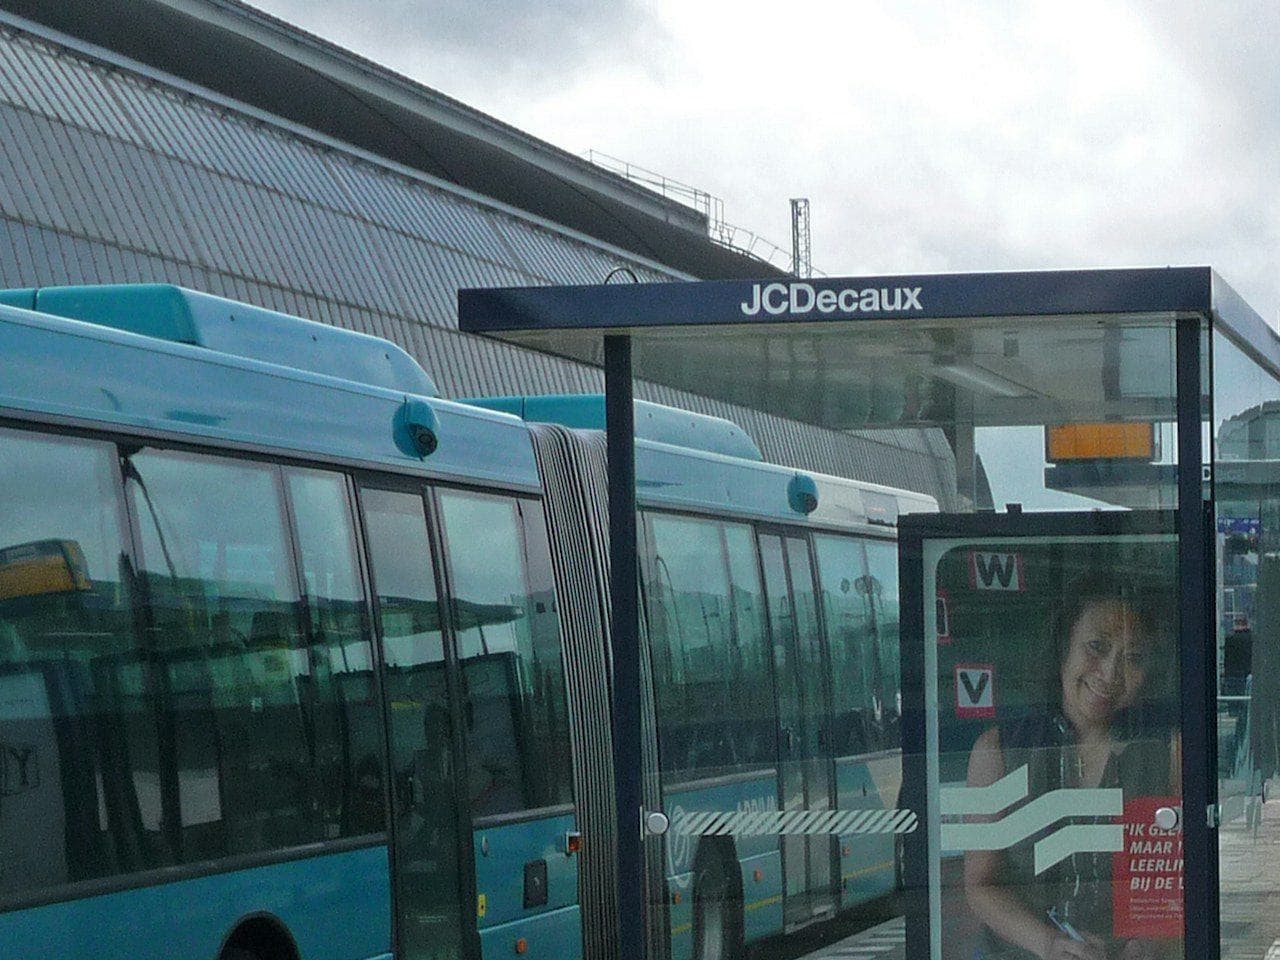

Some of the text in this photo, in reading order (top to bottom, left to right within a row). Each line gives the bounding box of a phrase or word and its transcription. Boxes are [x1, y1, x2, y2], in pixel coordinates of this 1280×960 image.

[741, 283, 923, 315] JCDecaux
[976, 554, 1014, 587] W
[960, 671, 990, 704] V
[1130, 841, 1172, 854] MAAR
[1130, 877, 1151, 891] BIJ
[1154, 877, 1174, 890] DE
